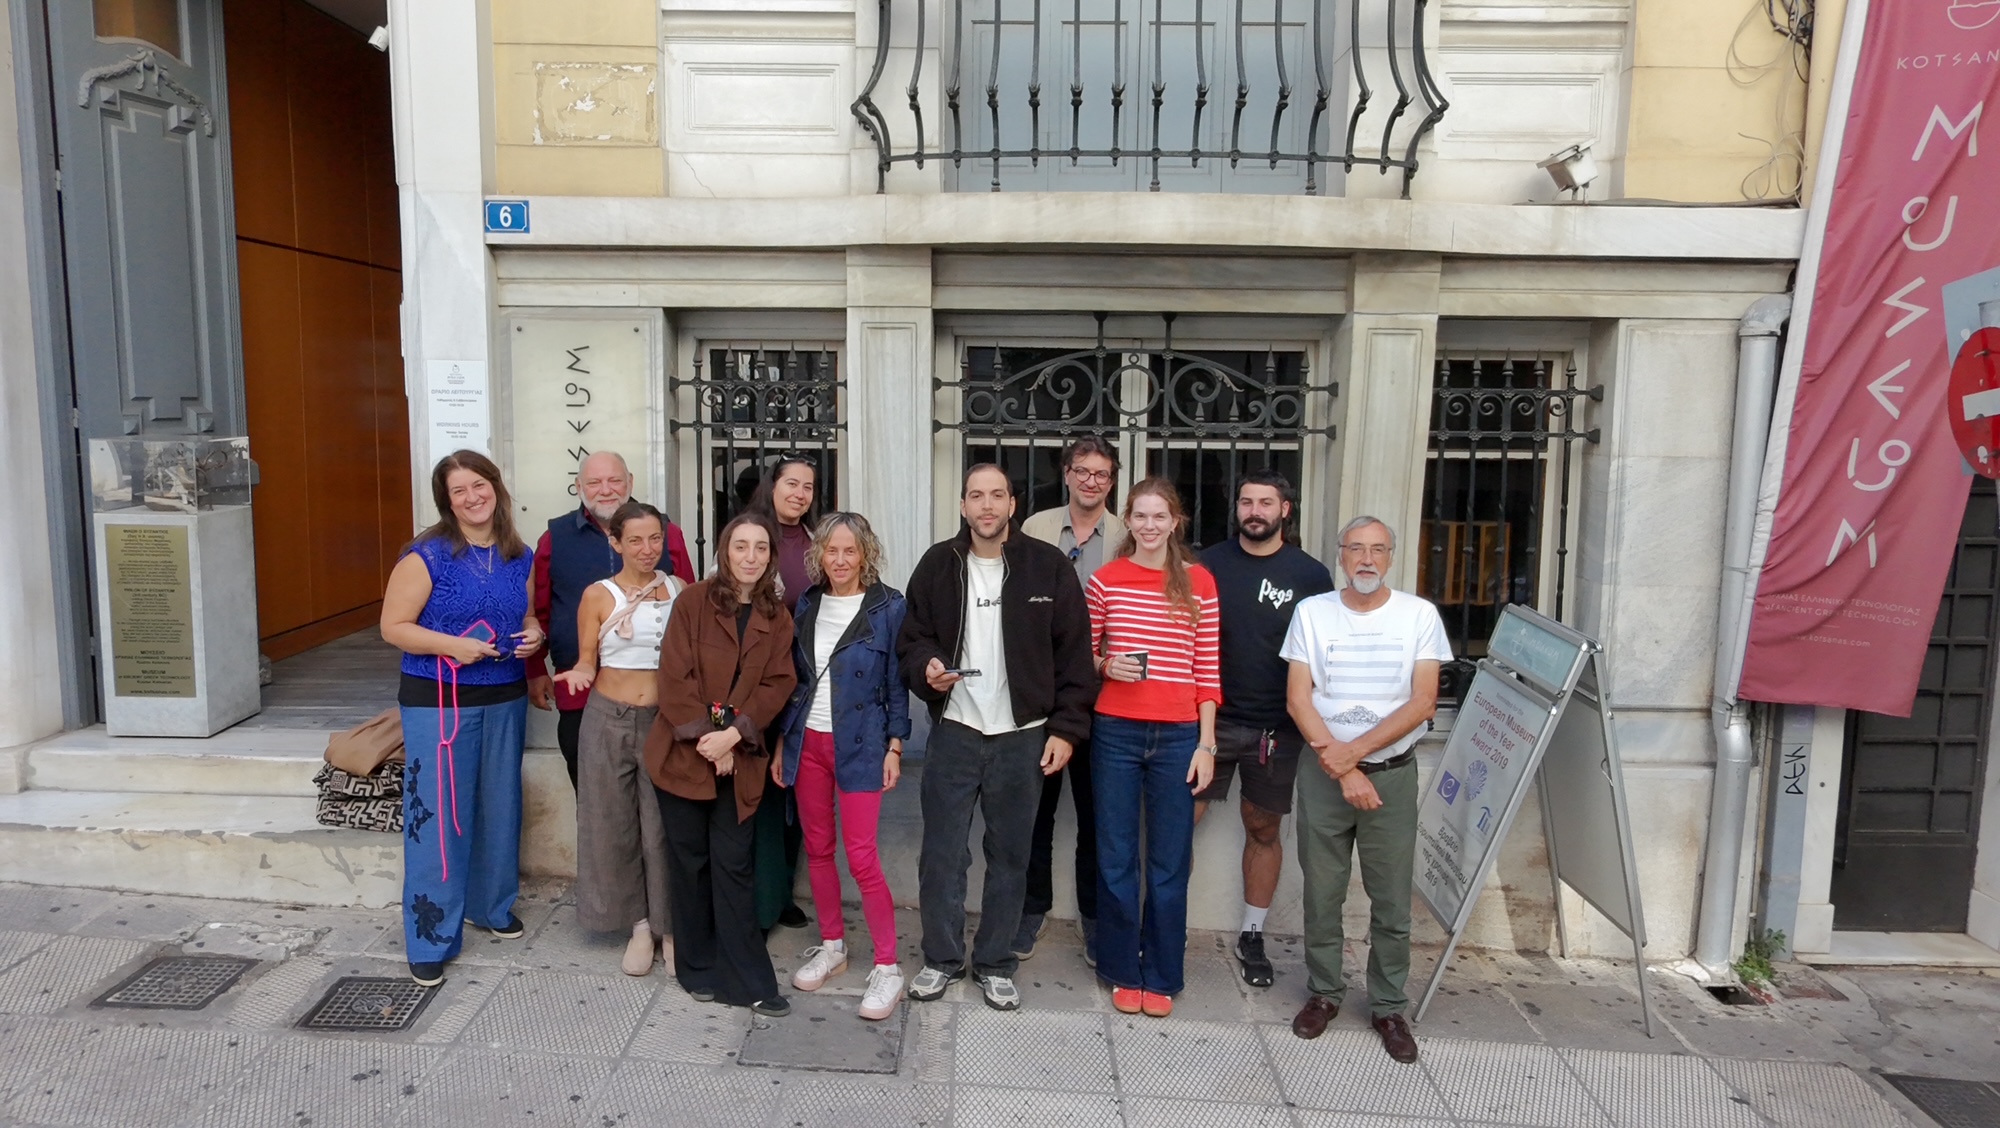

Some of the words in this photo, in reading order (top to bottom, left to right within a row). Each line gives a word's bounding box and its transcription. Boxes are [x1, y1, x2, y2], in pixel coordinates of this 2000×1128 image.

[499, 205, 512, 228] 6
[1474, 691, 1506, 722] European
[1505, 714, 1536, 746] Museum
[1479, 719, 1489, 731] of
[1487, 722, 1499, 739] the
[1499, 731, 1515, 752] Year
[1470, 732, 1492, 756] Award
[1490, 748, 1509, 770] 2019
